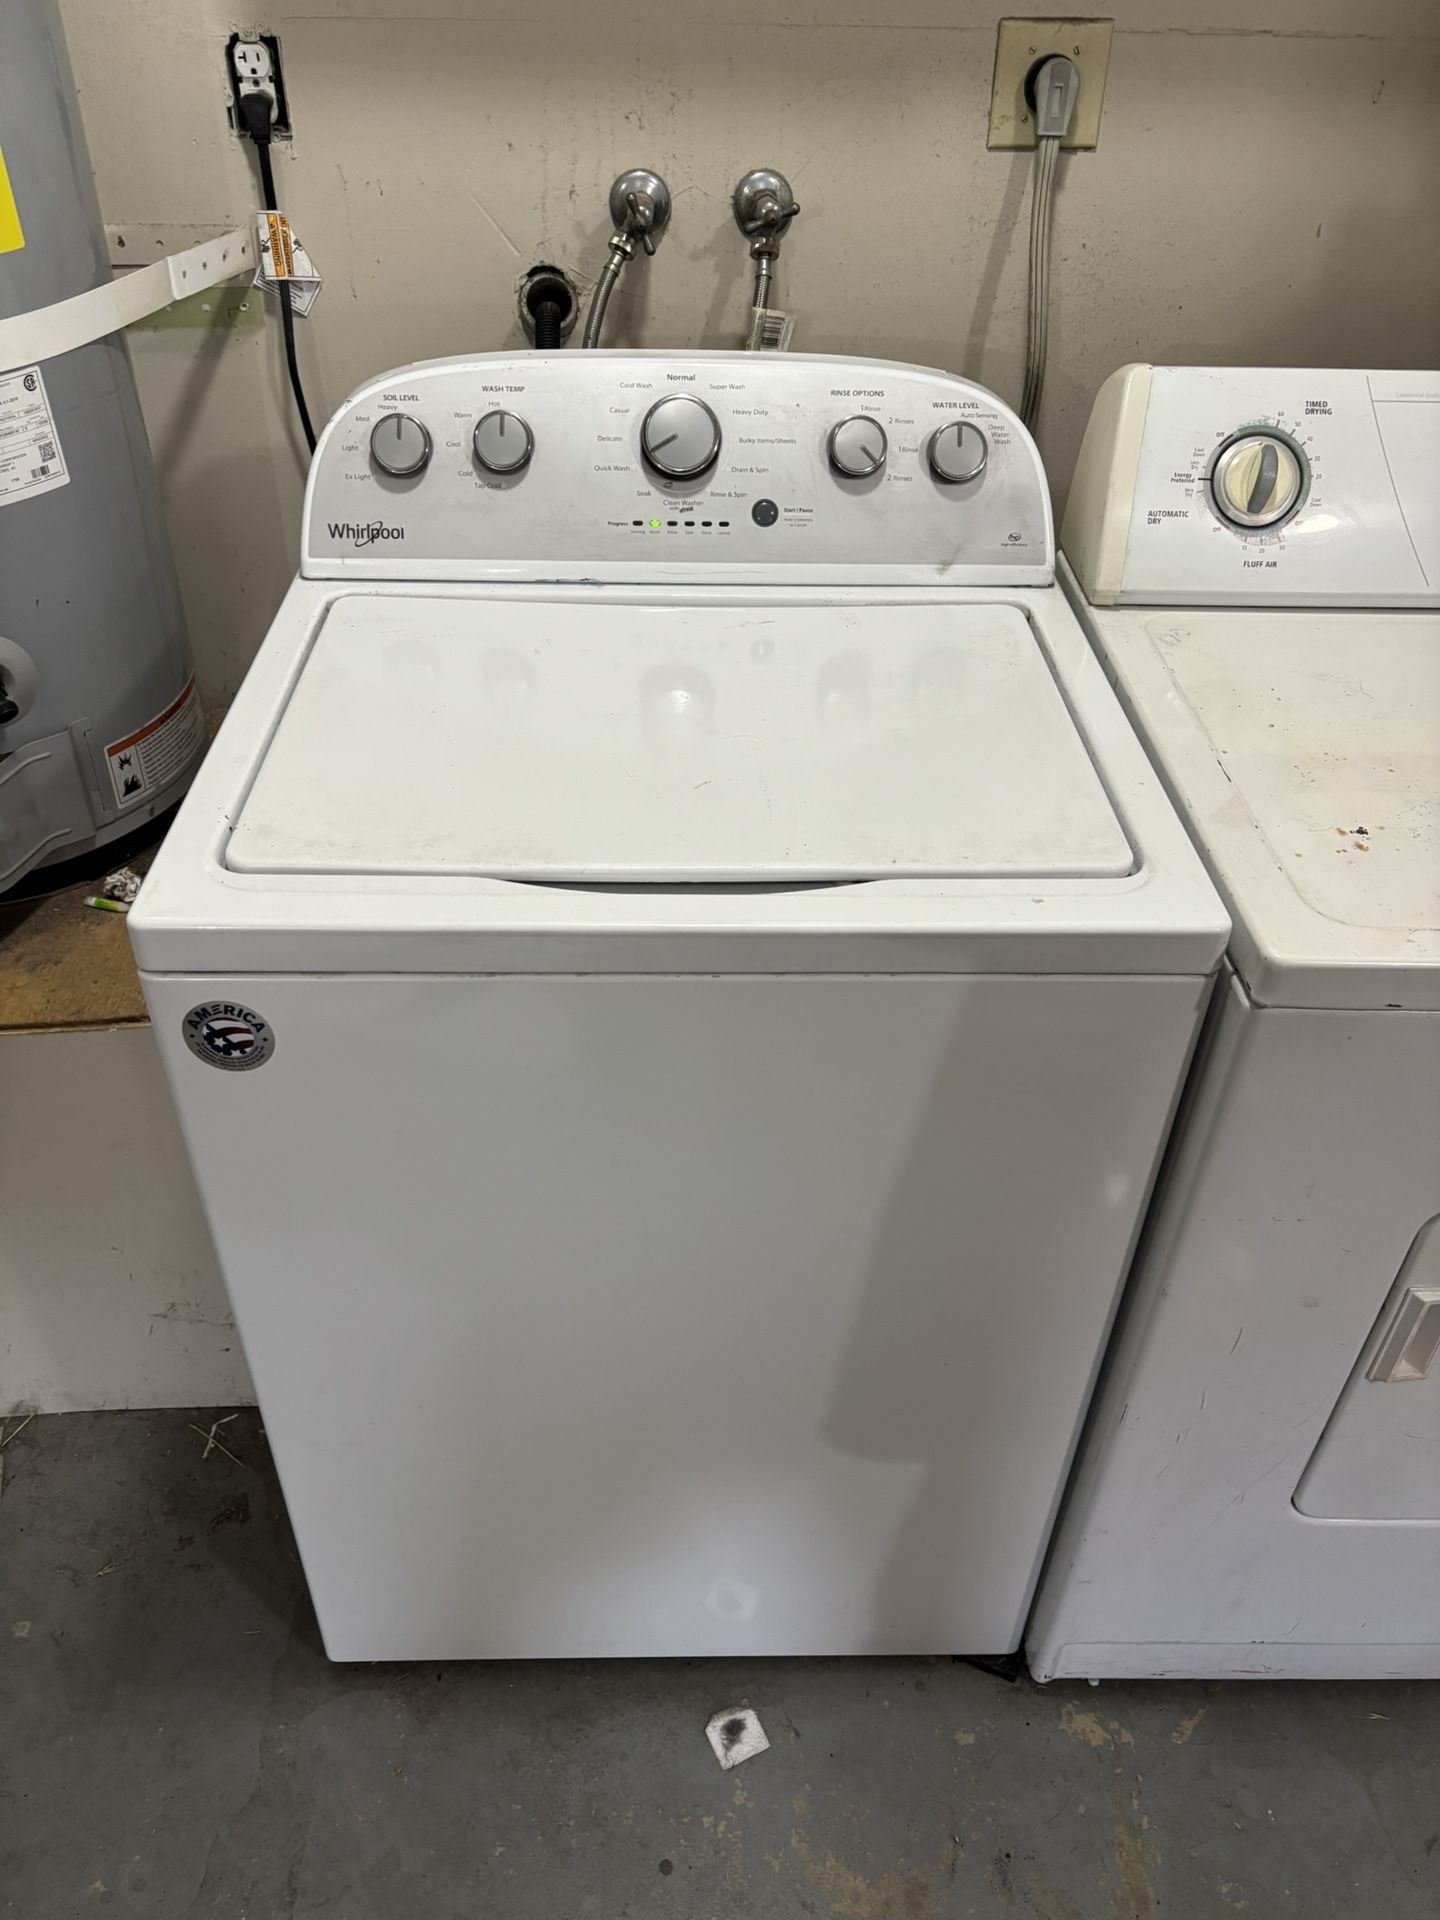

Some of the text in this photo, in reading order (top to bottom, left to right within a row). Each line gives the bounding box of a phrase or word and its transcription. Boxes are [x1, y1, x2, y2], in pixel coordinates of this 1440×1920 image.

[667, 373, 696, 382] Normal
[482, 385, 504, 393] WASH
[709, 383, 728, 391] Super
[383, 394, 420, 402] SOIL LEVEL
[852, 390, 885, 398] OPTIONS
[377, 403, 398, 411] Heavy
[958, 402, 980, 410] LEVEL
[1305, 400, 1328, 408] TIMED
[732, 408, 769, 417] Heavy Duty
[975, 412, 998, 420] Sensing
[1304, 408, 1333, 416] DRYING
[988, 424, 1006, 432] Deep
[446, 440, 461, 448] Cool
[738, 437, 797, 445] Bulky Items/Sheets
[341, 444, 359, 452] Light
[594, 465, 612, 473] Quick
[354, 473, 372, 481] Light
[887, 474, 892, 482] 2
[474, 482, 486, 490] Tap
[733, 491, 748, 499] Spin
[662, 499, 704, 507] Clean Washer
[1148, 510, 1190, 519] AUTOMATIC
[607, 520, 629, 528] Progress
[328, 522, 405, 546] Whirlpool
[1243, 560, 1278, 568] FLUFF AIR
[187, 1003, 266, 1033] AMERICA
